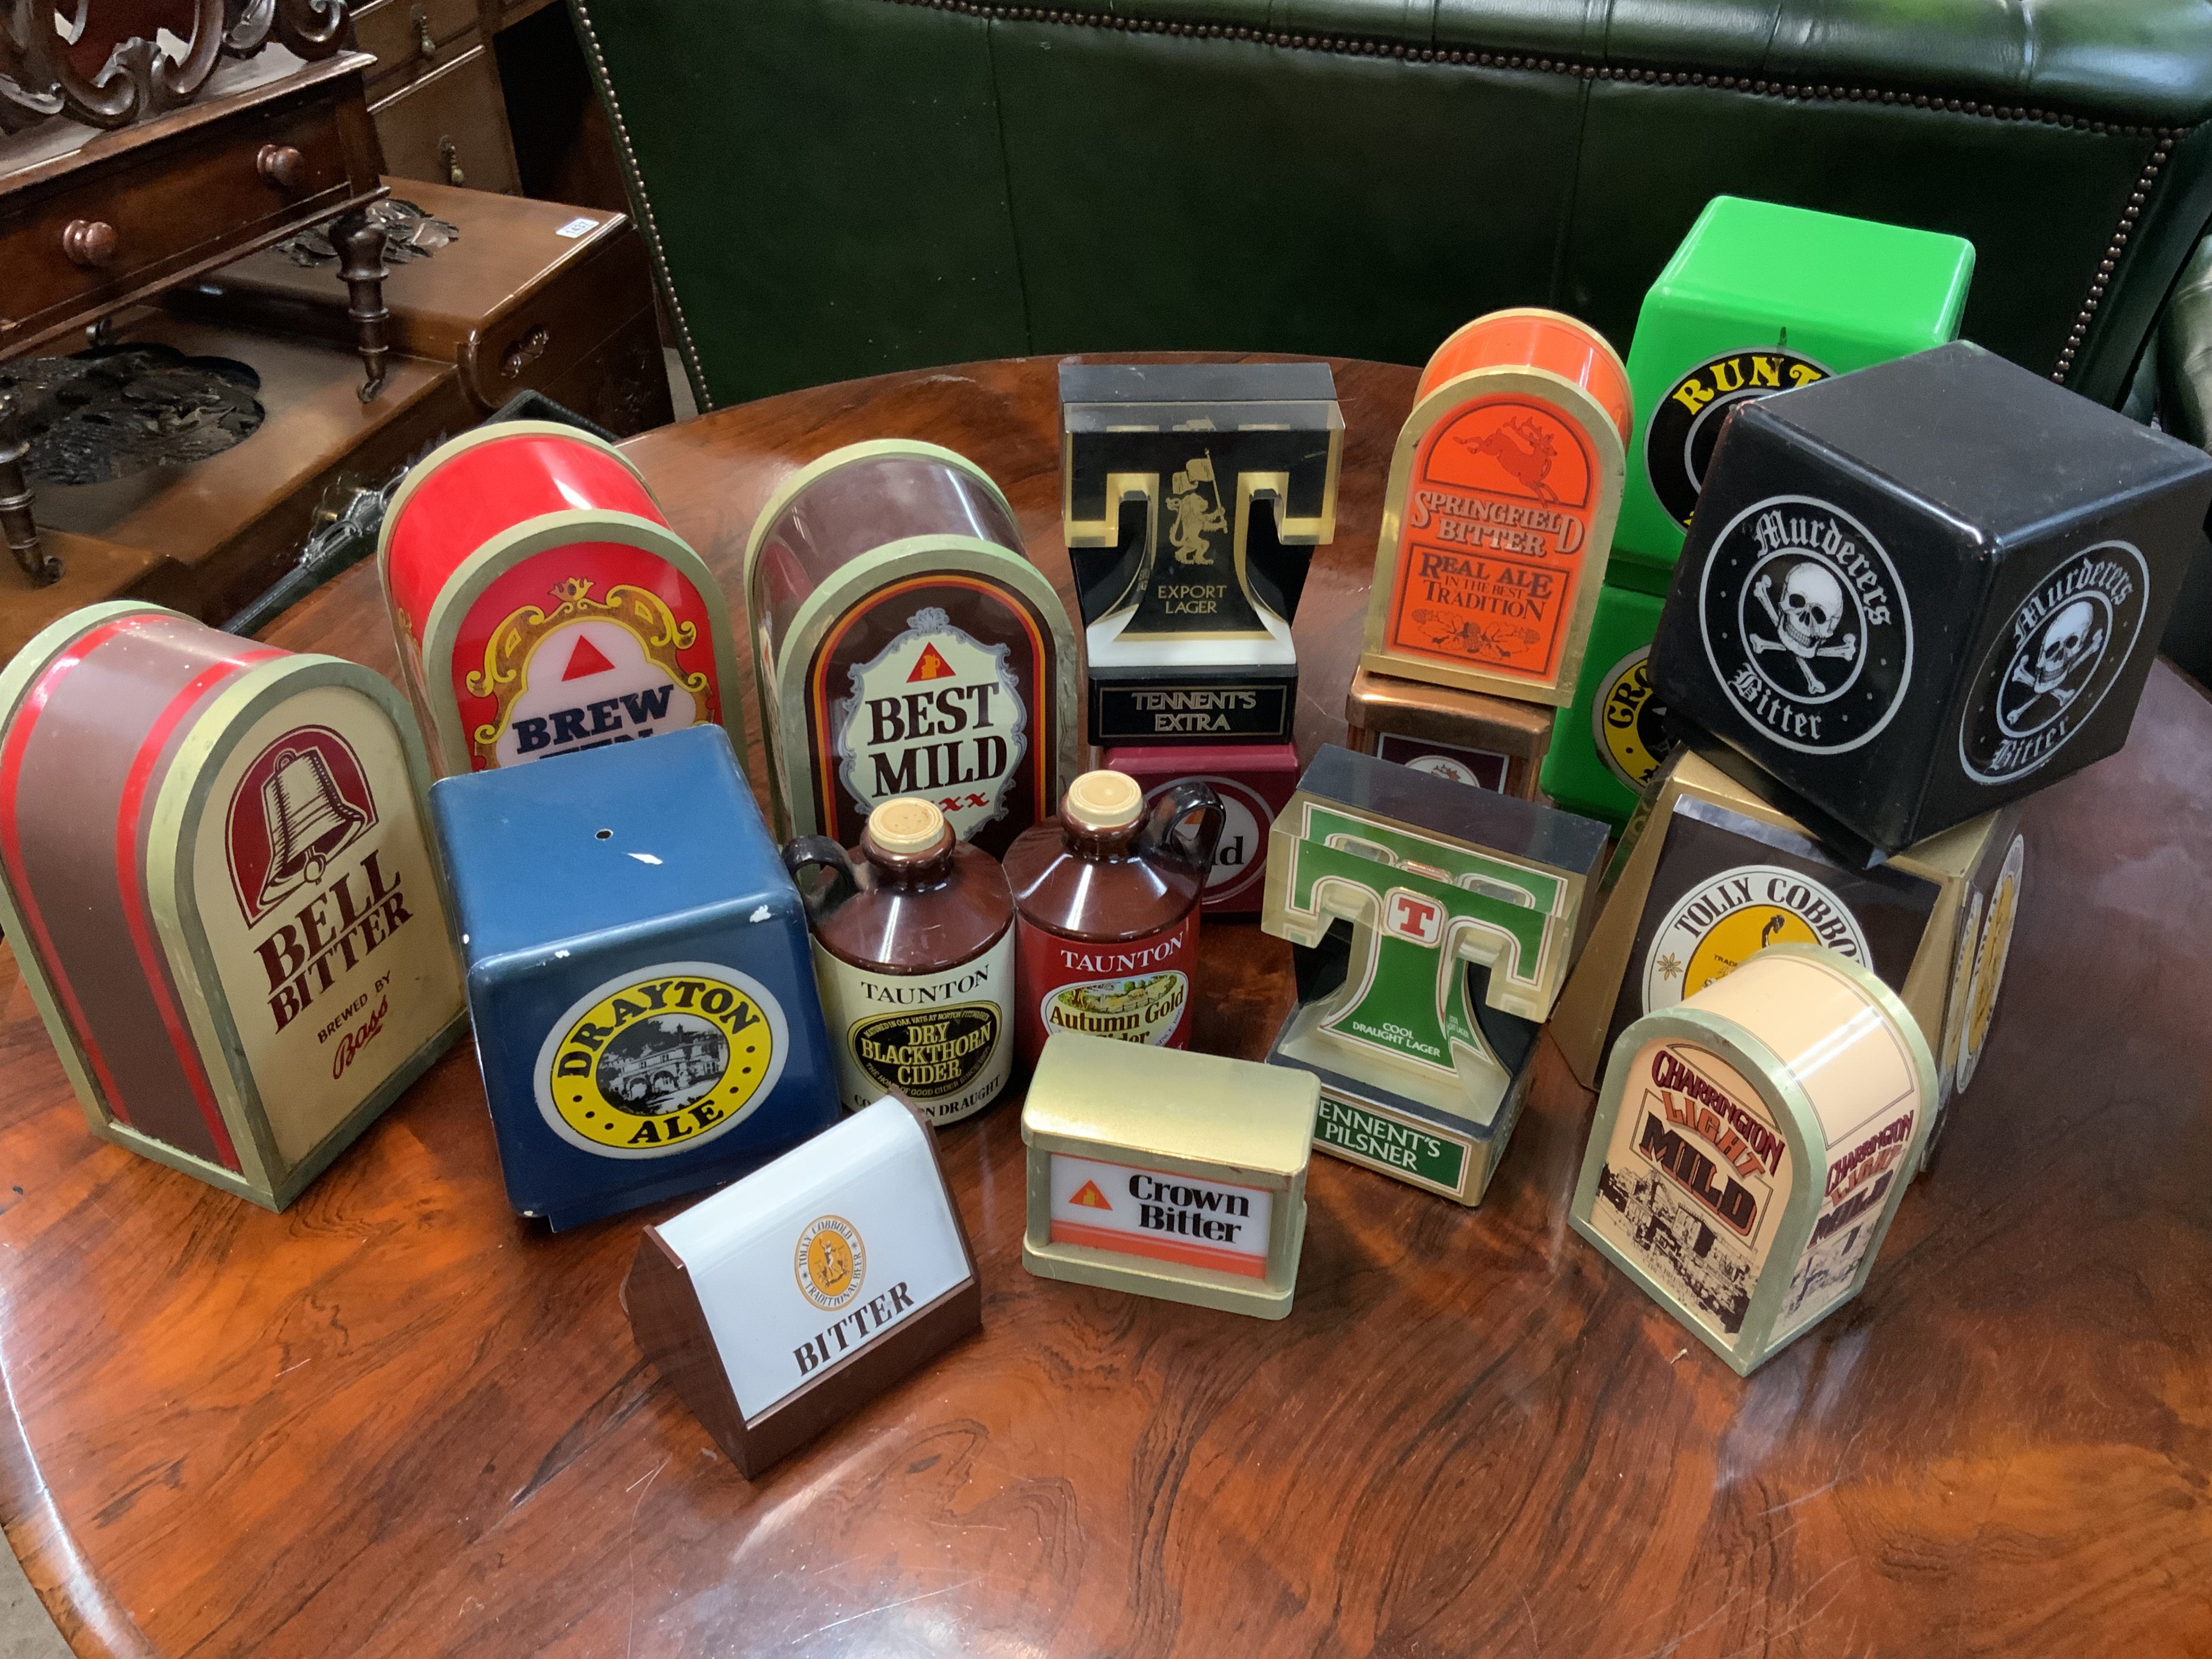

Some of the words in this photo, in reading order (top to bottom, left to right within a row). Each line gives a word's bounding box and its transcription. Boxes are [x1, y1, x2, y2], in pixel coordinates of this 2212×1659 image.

[1411, 490, 1585, 555] SPRINGFIELD
[1436, 517, 1547, 557] BITTER
[1158, 585, 1227, 600] EXPORT
[1419, 552, 1491, 580] REAL
[1497, 567, 1553, 600] ALE
[1445, 576, 1458, 586] IN
[1464, 579, 1487, 592] THE
[1493, 584, 1523, 599] BEST
[1754, 510, 1892, 625] Murderers
[1165, 601, 1217, 614] LAGER
[1424, 580, 1545, 622] TRADITION
[2013, 557, 2134, 649] Murderers
[512, 684, 674, 755] BREW
[865, 682, 1000, 746] BEST
[1131, 691, 1256, 710] TENNENT'S
[1155, 714, 1231, 732] EXTRA
[1728, 662, 1821, 740] Bitter
[868, 736, 1007, 798] MILD
[1988, 715, 2069, 770] Bitter
[254, 849, 400, 994] BELL
[1674, 877, 1755, 939] TOLLY
[1767, 878, 1858, 958] COBBO
[268, 891, 413, 1035] BITTER
[1060, 932, 1183, 972] TAUNTON
[318, 993, 368, 1045] BREWED
[375, 970, 391, 995] BY
[861, 964, 989, 1005] TAUNTON
[1049, 1006, 1141, 1032] Autumn
[1144, 984, 1184, 1024] Gold
[332, 994, 388, 1080] Bass
[557, 981, 760, 1079] DRAYTON
[861, 1021, 991, 1065] BLACKTHORN
[908, 1022, 950, 1046] DRY
[1352, 1022, 1404, 1045] DRAUGHT
[1406, 1039, 1441, 1058] LAGER
[1383, 1023, 1414, 1040] COOL
[898, 1059, 962, 1085] CIDER
[911, 1088, 933, 1096] GOOD
[934, 1081, 960, 1094] CIDER
[939, 1074, 1001, 1116] DRAUGHT
[628, 1100, 724, 1144] ALE
[1319, 1099, 1441, 1158] ENNENT'S
[1651, 1049, 1785, 1177] CHARRINGTON
[1661, 1090, 1766, 1181] LIGHT
[1325, 1122, 1417, 1171] PILSNER
[1825, 1110, 1914, 1198] CHARRINGTON
[1128, 1174, 1250, 1217] Crown
[1639, 1111, 1757, 1237] MILD
[1830, 1144, 1903, 1206] LIGHT
[1138, 1203, 1242, 1244] Bitter
[1808, 1169, 1893, 1249] MILD
[799, 1234, 812, 1268] TOLLY
[811, 1220, 853, 1240] COBBOLD
[805, 1282, 858, 1306] TRADITIONAL
[853, 1252, 862, 1279] BEER
[792, 1281, 915, 1377] BITTER
